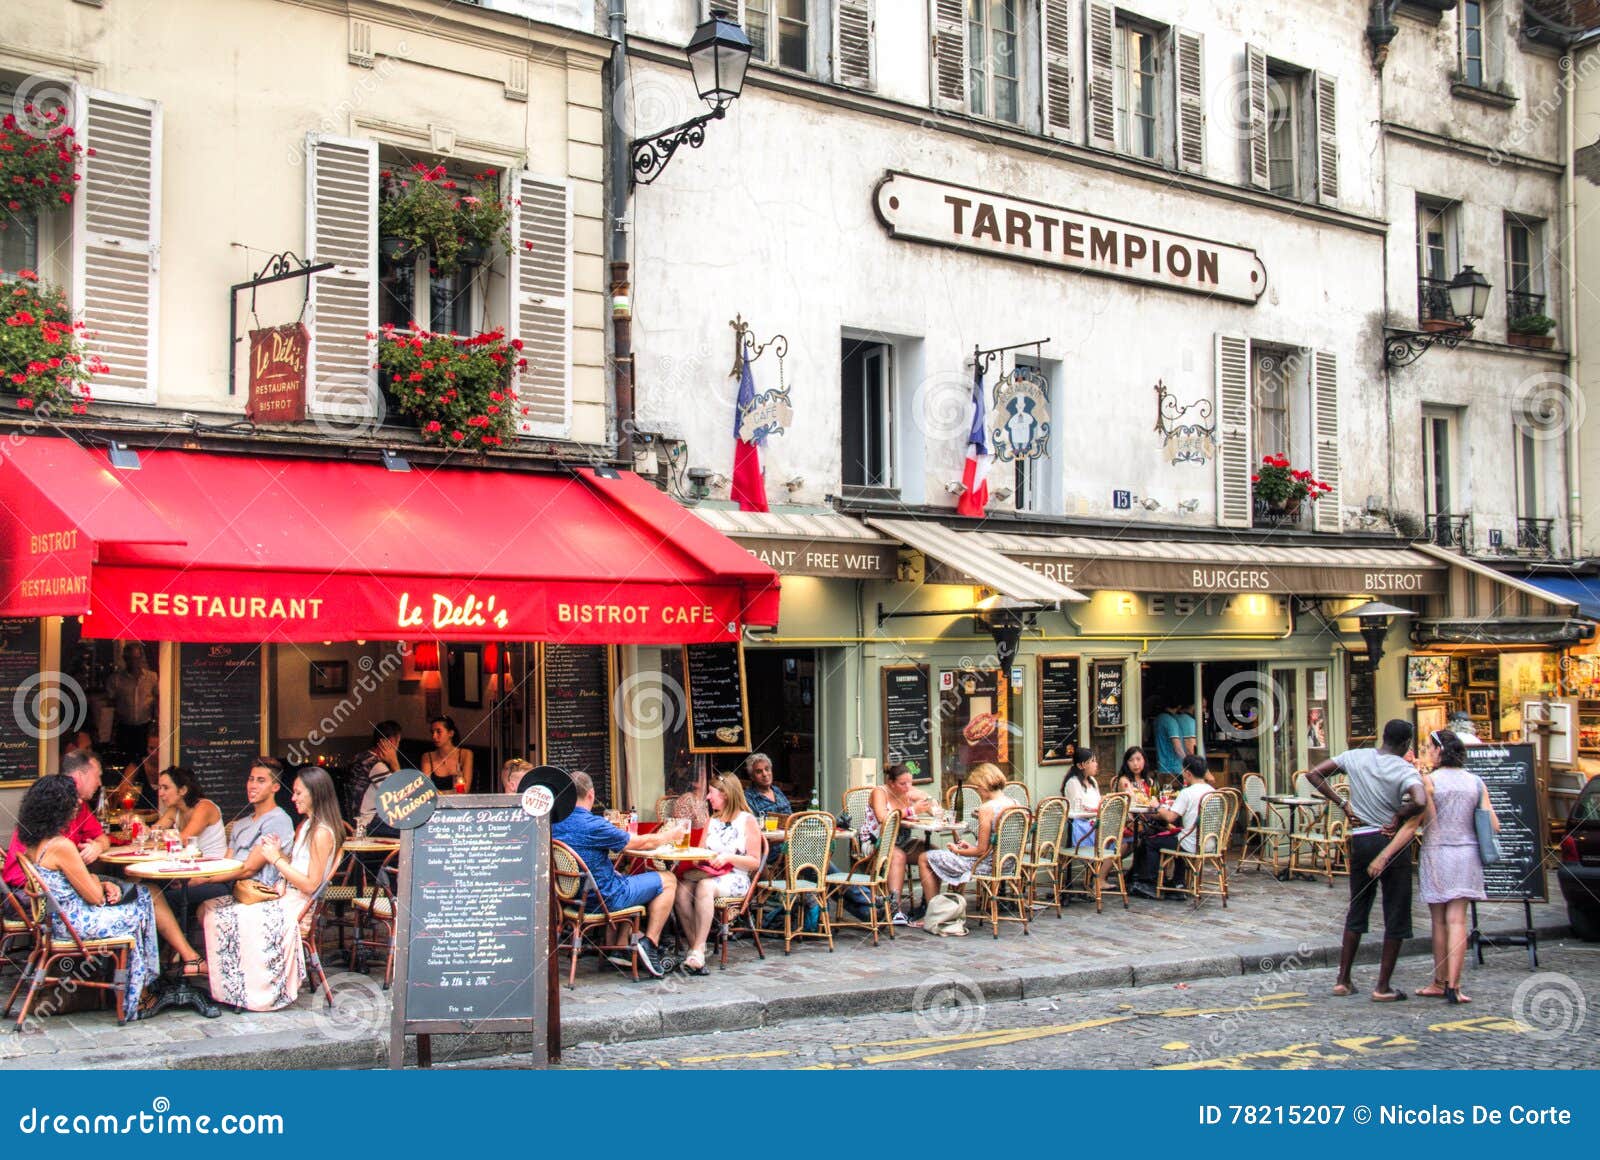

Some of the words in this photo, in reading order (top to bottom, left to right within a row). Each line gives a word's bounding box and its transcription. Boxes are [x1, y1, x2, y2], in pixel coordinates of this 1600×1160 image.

[944, 195, 1219, 284] TARTEMPION
[256, 344, 269, 379] Le
[256, 380, 300, 395] RESTAURANT
[260, 399, 291, 411] BISTROT
[1117, 492, 1129, 508] 15
[31, 530, 77, 554] BISTROT
[806, 552, 839, 568] FREE
[844, 554, 880, 570] WIFI
[21, 576, 87, 597] RESTAURANT
[1193, 569, 1270, 588] BURGERS
[1365, 574, 1423, 590] BISTROT
[131, 592, 323, 619] RESTAURANT
[398, 592, 423, 627] Le
[432, 593, 508, 628] Deli's
[558, 604, 649, 624] BISTROT
[662, 607, 714, 623] CAFE
[379, 775, 424, 812] Pizza
[387, 789, 434, 827] Maison
[458, 824, 472, 832] Plat
